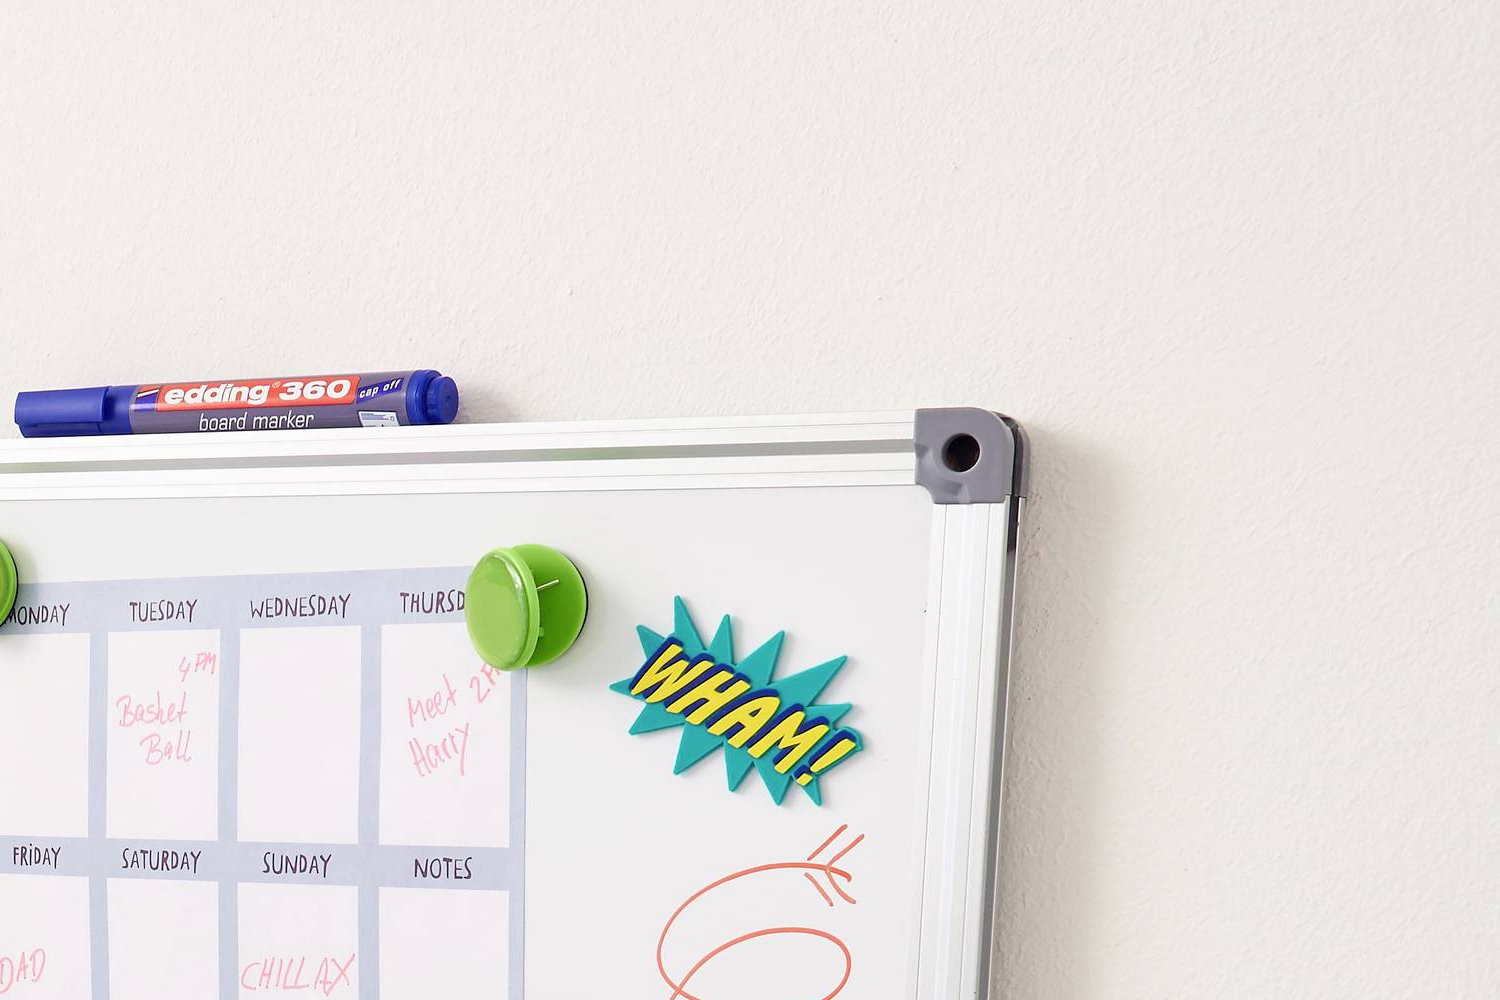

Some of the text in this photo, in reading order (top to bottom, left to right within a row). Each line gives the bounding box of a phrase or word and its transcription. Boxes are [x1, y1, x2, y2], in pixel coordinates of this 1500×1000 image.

[278, 379, 352, 401] 360
[359, 378, 402, 399] cap off
[199, 410, 315, 432] board marker
[129, 599, 198, 624] TUESDAY
[249, 593, 352, 619] WEDNESDAY
[399, 588, 466, 615] THURSD
[115, 690, 189, 728] Basket
[406, 673, 458, 728] Meet
[628, 636, 858, 787] WHAM!
[139, 729, 193, 766] Ball
[408, 722, 471, 778] Harry
[121, 848, 202, 874] SATURDAY
[262, 852, 332, 879] SUNDAY
[414, 857, 473, 880] NOTES
[240, 953, 357, 997] CHILLAX
